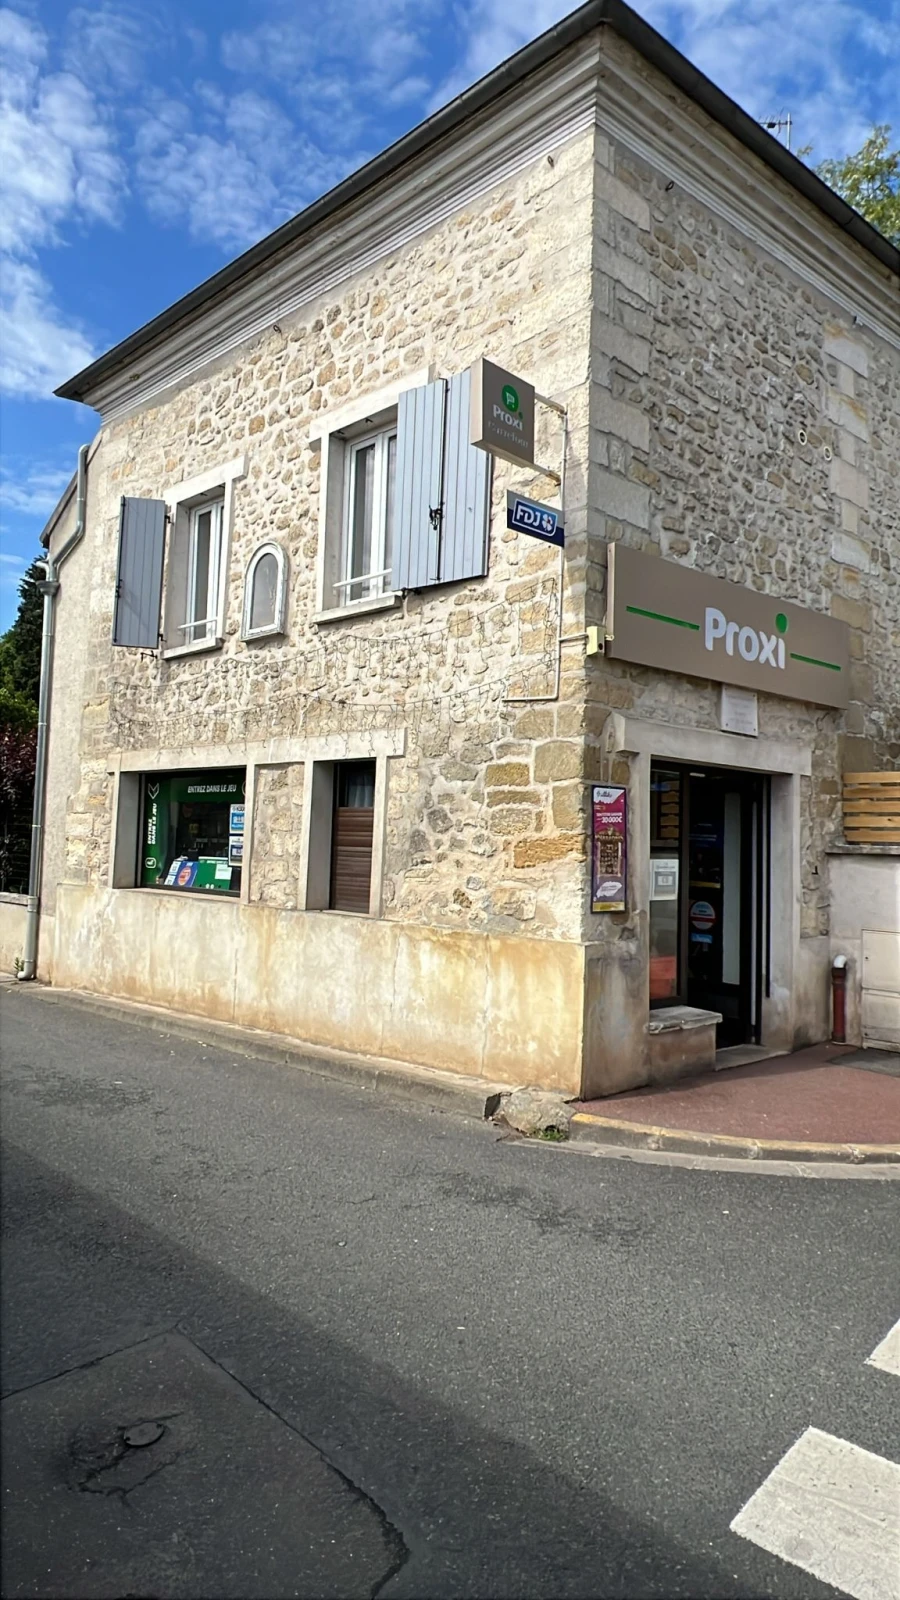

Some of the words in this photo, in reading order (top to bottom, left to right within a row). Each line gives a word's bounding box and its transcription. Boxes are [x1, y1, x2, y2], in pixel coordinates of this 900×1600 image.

[493, 403, 523, 431] Proxi
[516, 505, 541, 527] FDJ
[704, 607, 787, 670] Proxi
[187, 785, 206, 793] ENTREZ
[206, 785, 220, 793] DANS
[220, 784, 227, 792] LE
[227, 784, 237, 792] JEU
